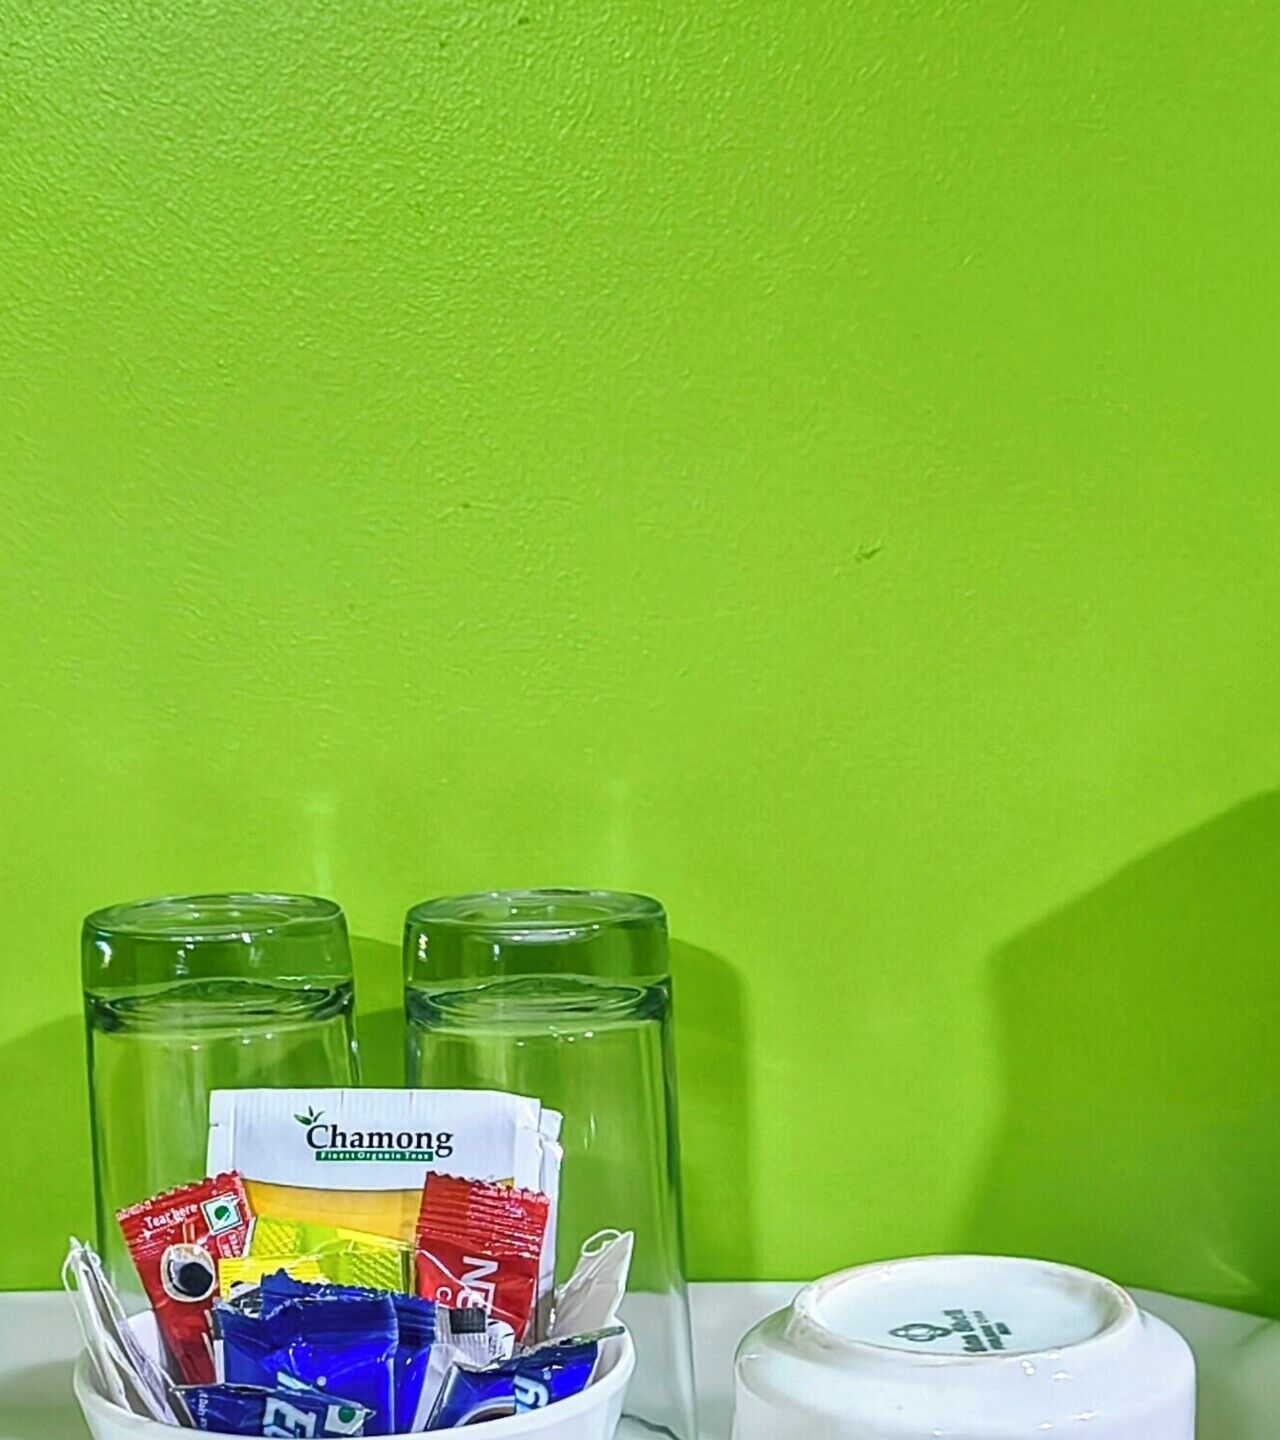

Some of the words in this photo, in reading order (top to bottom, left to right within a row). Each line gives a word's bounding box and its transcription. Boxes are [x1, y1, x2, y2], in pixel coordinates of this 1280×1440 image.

[306, 1124, 454, 1158] Chamong
[321, 1151, 355, 1160] Finest
[357, 1151, 402, 1161] Organic
[405, 1151, 429, 1160] Teas
[143, 1210, 172, 1229] Tear
[170, 1203, 199, 1222] here
